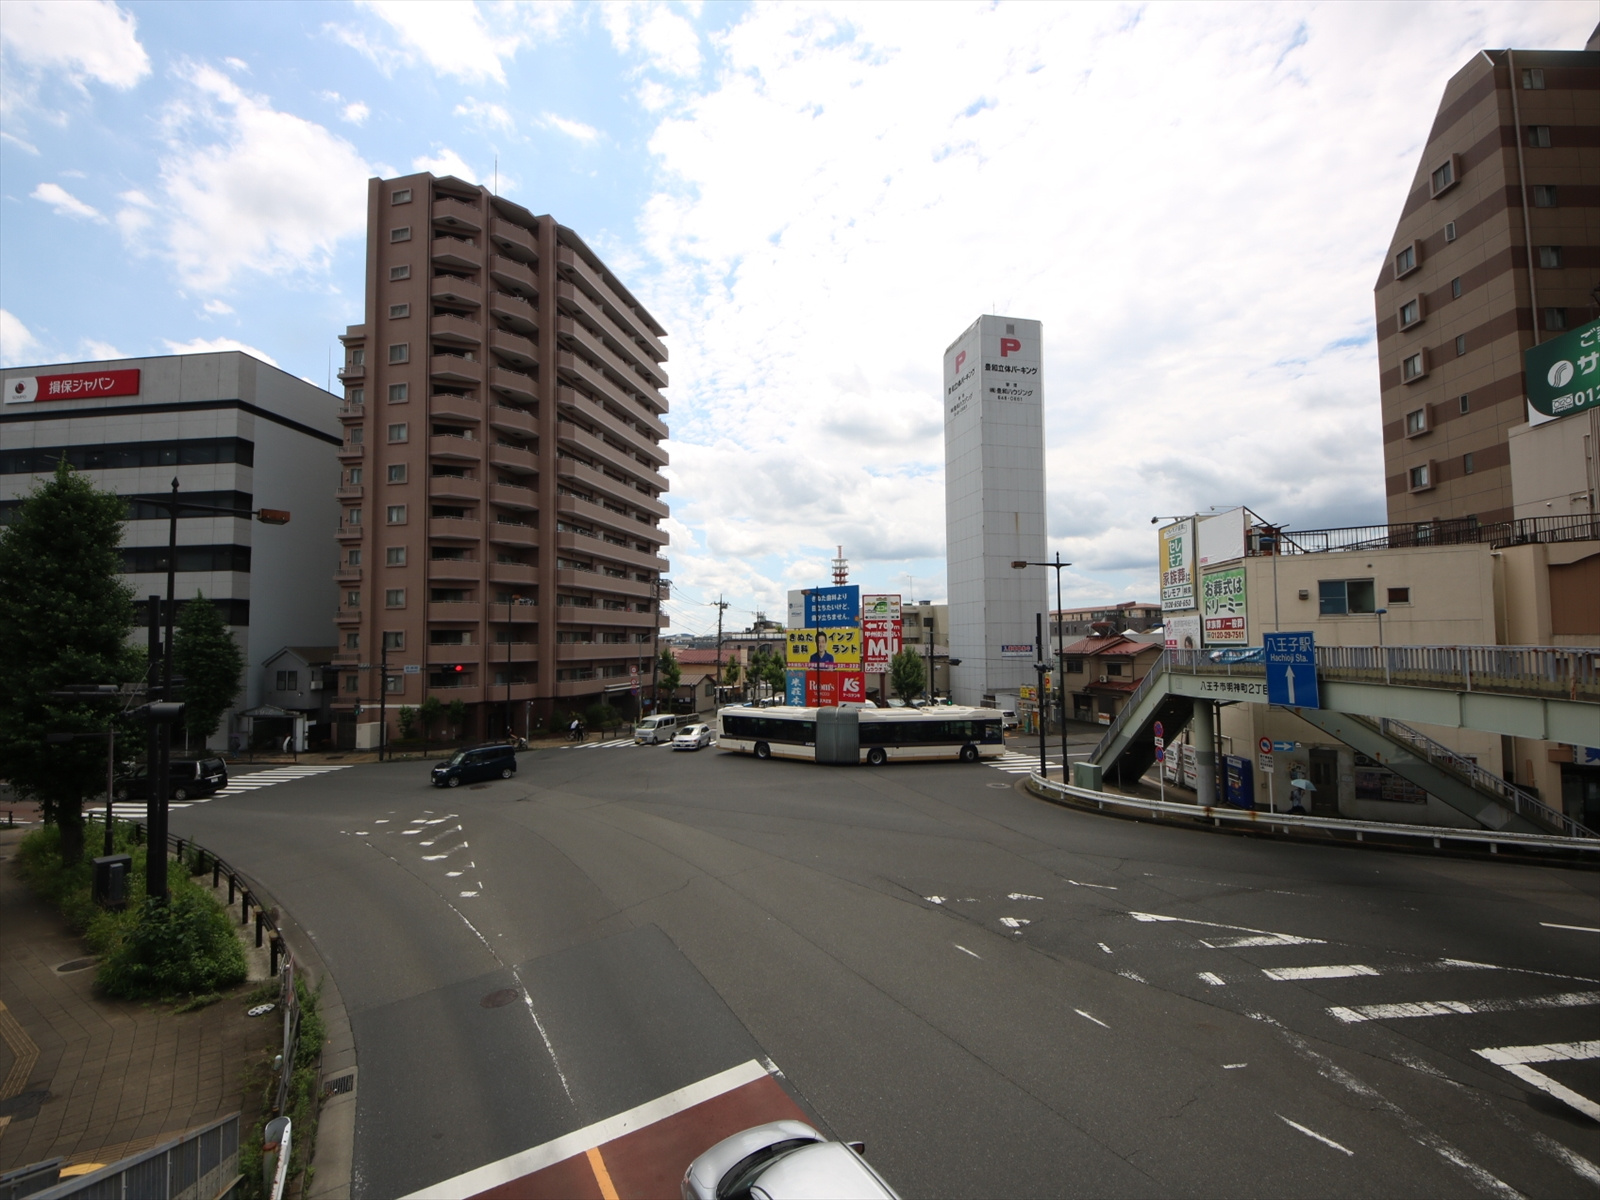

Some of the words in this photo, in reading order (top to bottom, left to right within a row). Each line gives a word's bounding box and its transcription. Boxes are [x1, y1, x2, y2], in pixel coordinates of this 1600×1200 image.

[1000, 338, 1021, 357] P
[955, 350, 967, 375] P
[48, 377, 115, 395] 損保ジャパン
[1163, 567, 1191, 586] 家族葬は
[1163, 587, 1181, 599] セレモア
[1205, 577, 1243, 597] お葬式は
[1205, 597, 1243, 615] ドリーミー
[789, 633, 813, 642] きぬた
[1266, 636, 1312, 652] 八王子駅
[792, 645, 809, 654] 歯科
[832, 644, 858, 653] ラント
[1270, 653, 1295, 664] Hachioji
[1296, 653, 1309, 663] Sta.
[1200, 680, 1268, 696] 八王子市明神町2丁目
